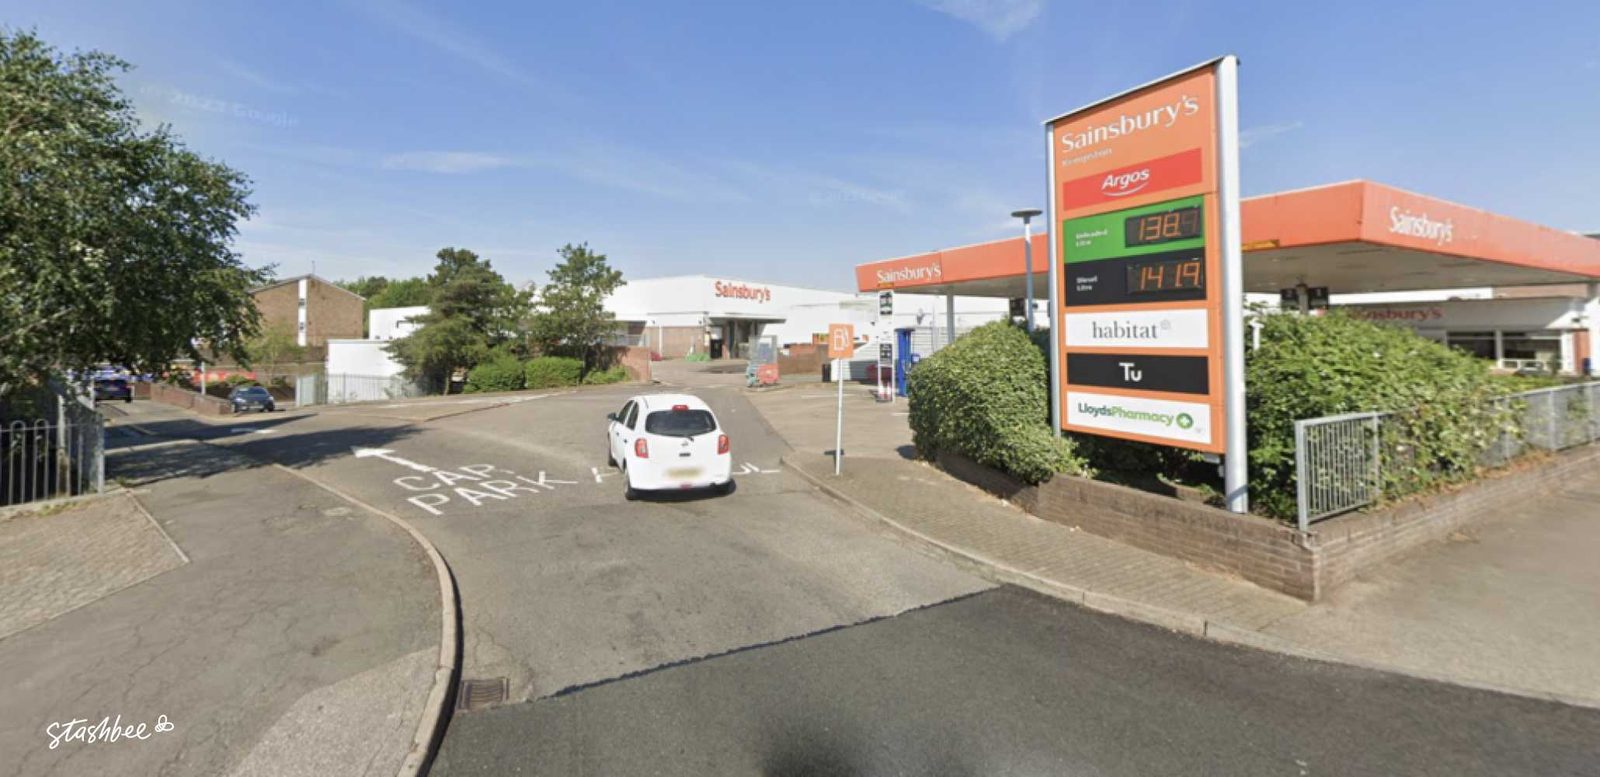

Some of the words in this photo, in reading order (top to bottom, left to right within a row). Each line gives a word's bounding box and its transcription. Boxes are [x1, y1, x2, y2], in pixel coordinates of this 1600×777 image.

[1061, 95, 1199, 153] Sainsbury's
[1101, 168, 1150, 190] Argos
[1389, 206, 1452, 246] Sainsbury's
[876, 262, 941, 283] Sainsbury's
[714, 280, 771, 304] Sainsbury's
[1092, 321, 1157, 339] habitat
[1118, 362, 1142, 382] Tu
[1078, 402, 1174, 427] LloydsPharmacy
[407, 471, 579, 516] PARK
